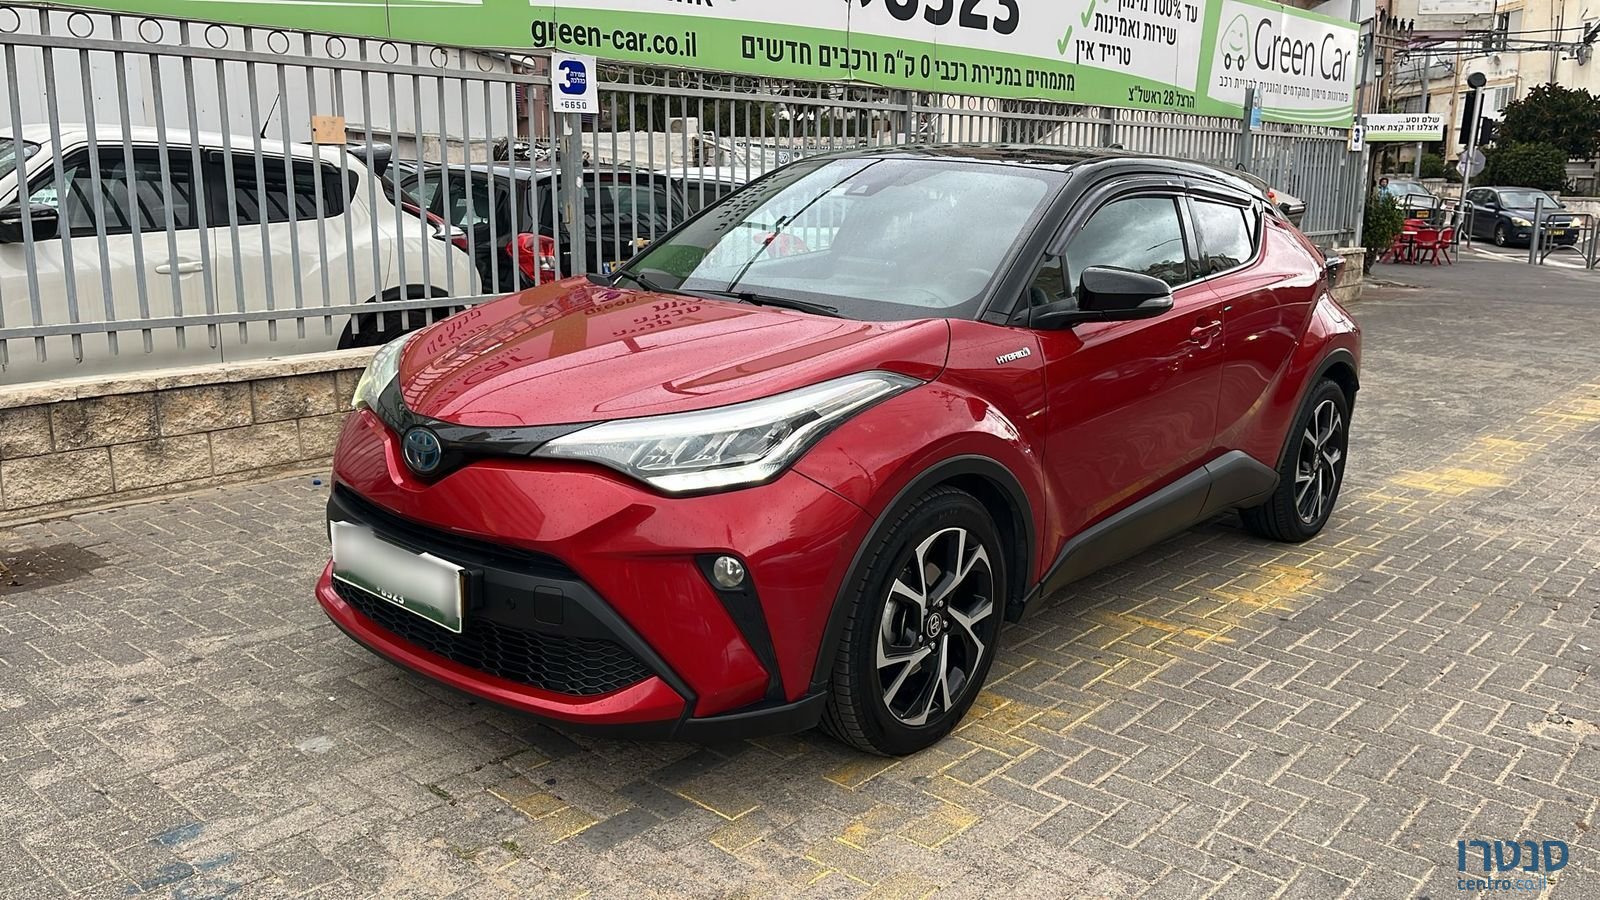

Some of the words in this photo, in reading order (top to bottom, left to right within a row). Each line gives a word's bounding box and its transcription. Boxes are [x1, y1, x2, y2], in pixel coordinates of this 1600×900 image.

[1153, 0, 1182, 19] 100%
[1184, 4, 1198, 23] עד
[1094, 12, 1140, 39] ואמינות
[1143, 22, 1177, 46] שירות
[531, 19, 697, 57] green-car.co.il
[741, 35, 812, 66] חדשים
[819, 44, 878, 73] ורכבים
[1076, 39, 1095, 65] אין
[1098, 42, 1131, 66] טרייד
[1254, 18, 1315, 78] Green
[1320, 33, 1351, 82] Car
[558, 60, 587, 95] 3
[920, 54, 931, 79] 0
[934, 60, 968, 83] רכבי
[971, 64, 1022, 87] במכירת
[1026, 69, 1075, 92] מתמחים
[1218, 75, 1233, 88] רכב
[1163, 92, 1174, 107] 28
[1176, 90, 1195, 109] הרצל
[1387, 124, 1404, 132] קצת
[1421, 116, 1440, 124] שלם
[995, 348, 1027, 365] HYBRID
